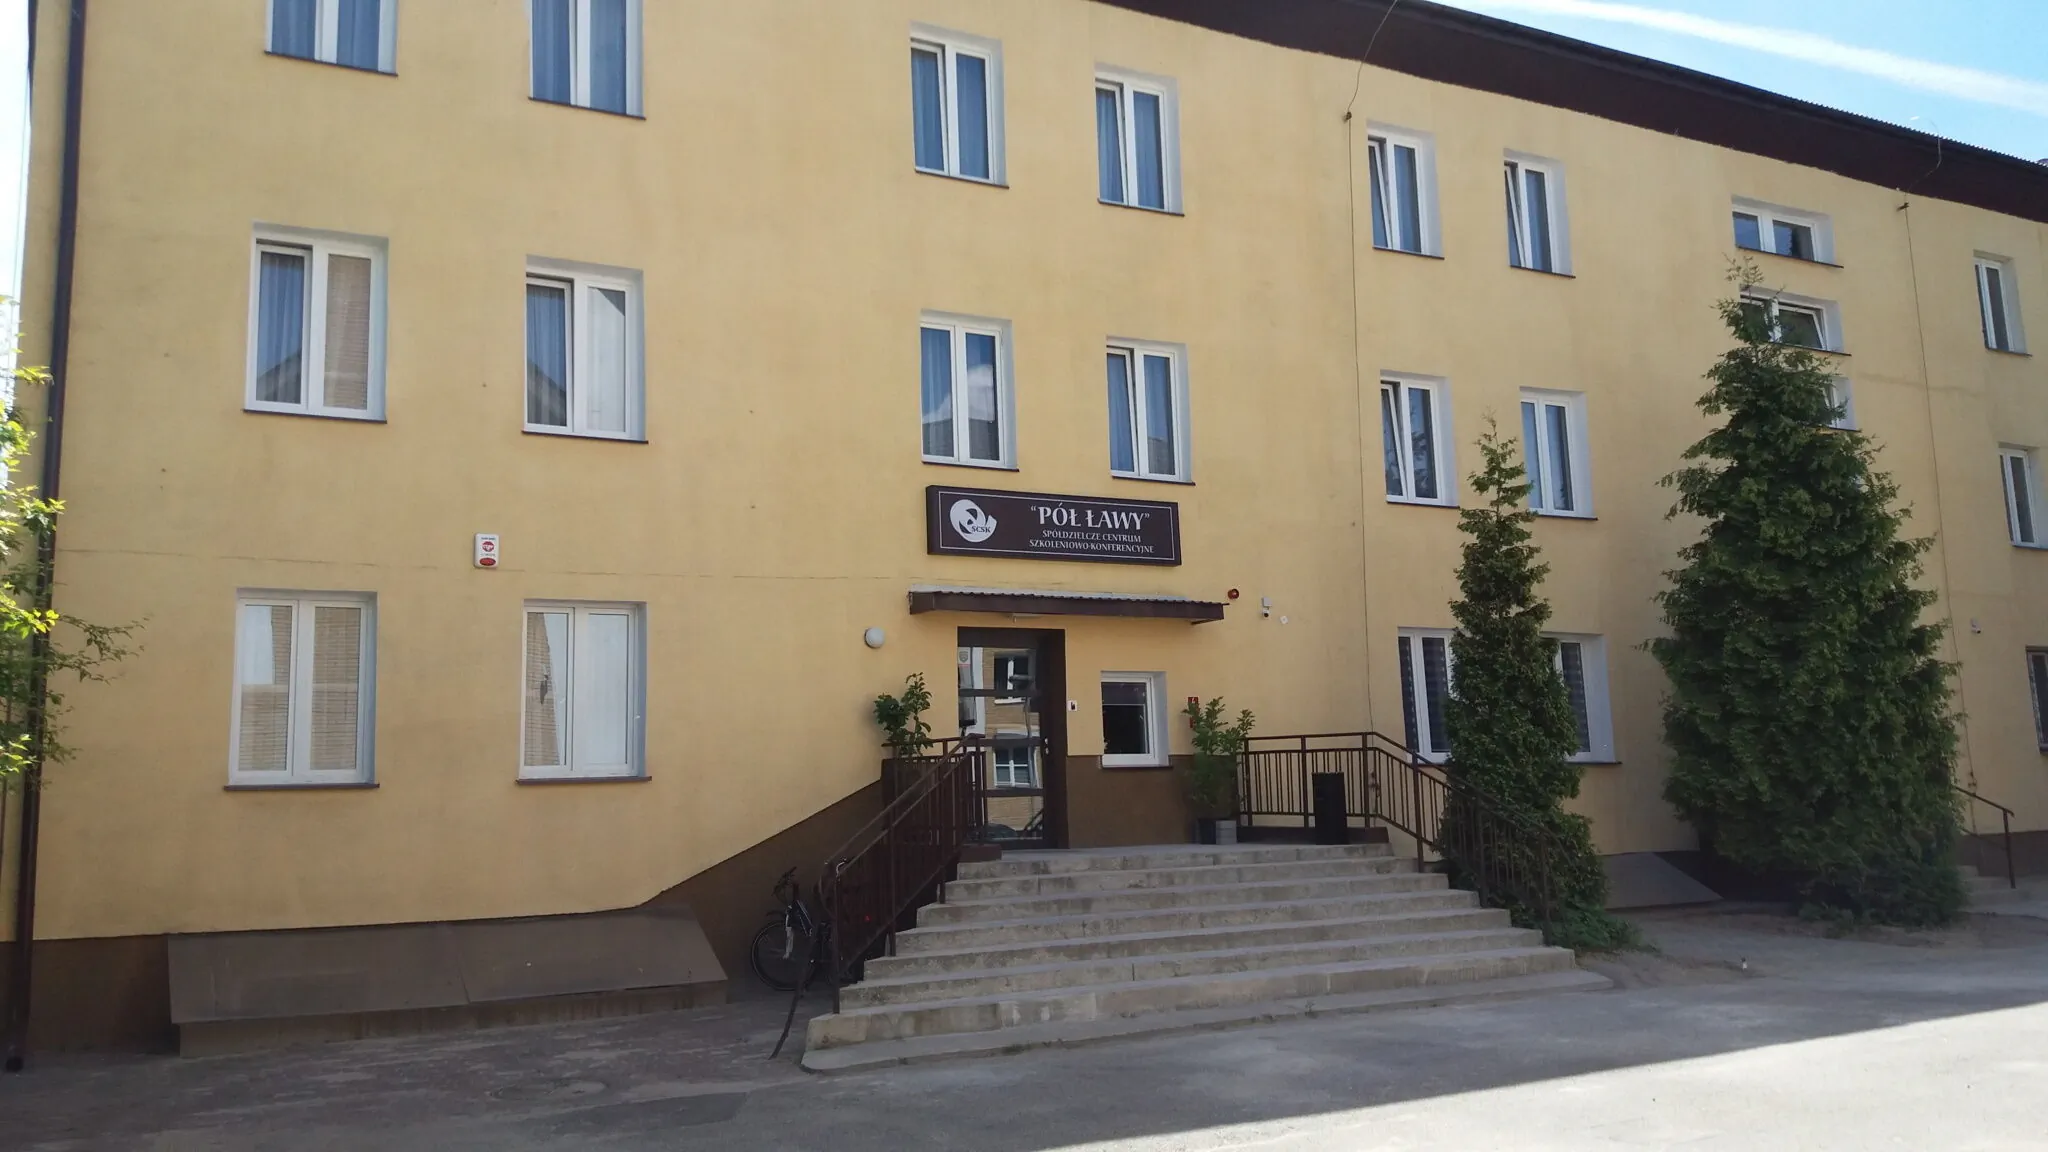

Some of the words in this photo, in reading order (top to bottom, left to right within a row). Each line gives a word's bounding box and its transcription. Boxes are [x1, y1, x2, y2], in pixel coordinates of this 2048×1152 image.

[971, 525, 991, 533] SCSK
[1102, 533, 1141, 543] CENTRUM
[1029, 539, 1154, 554] SZKOLENIOWO-KONFERENCYJNE
